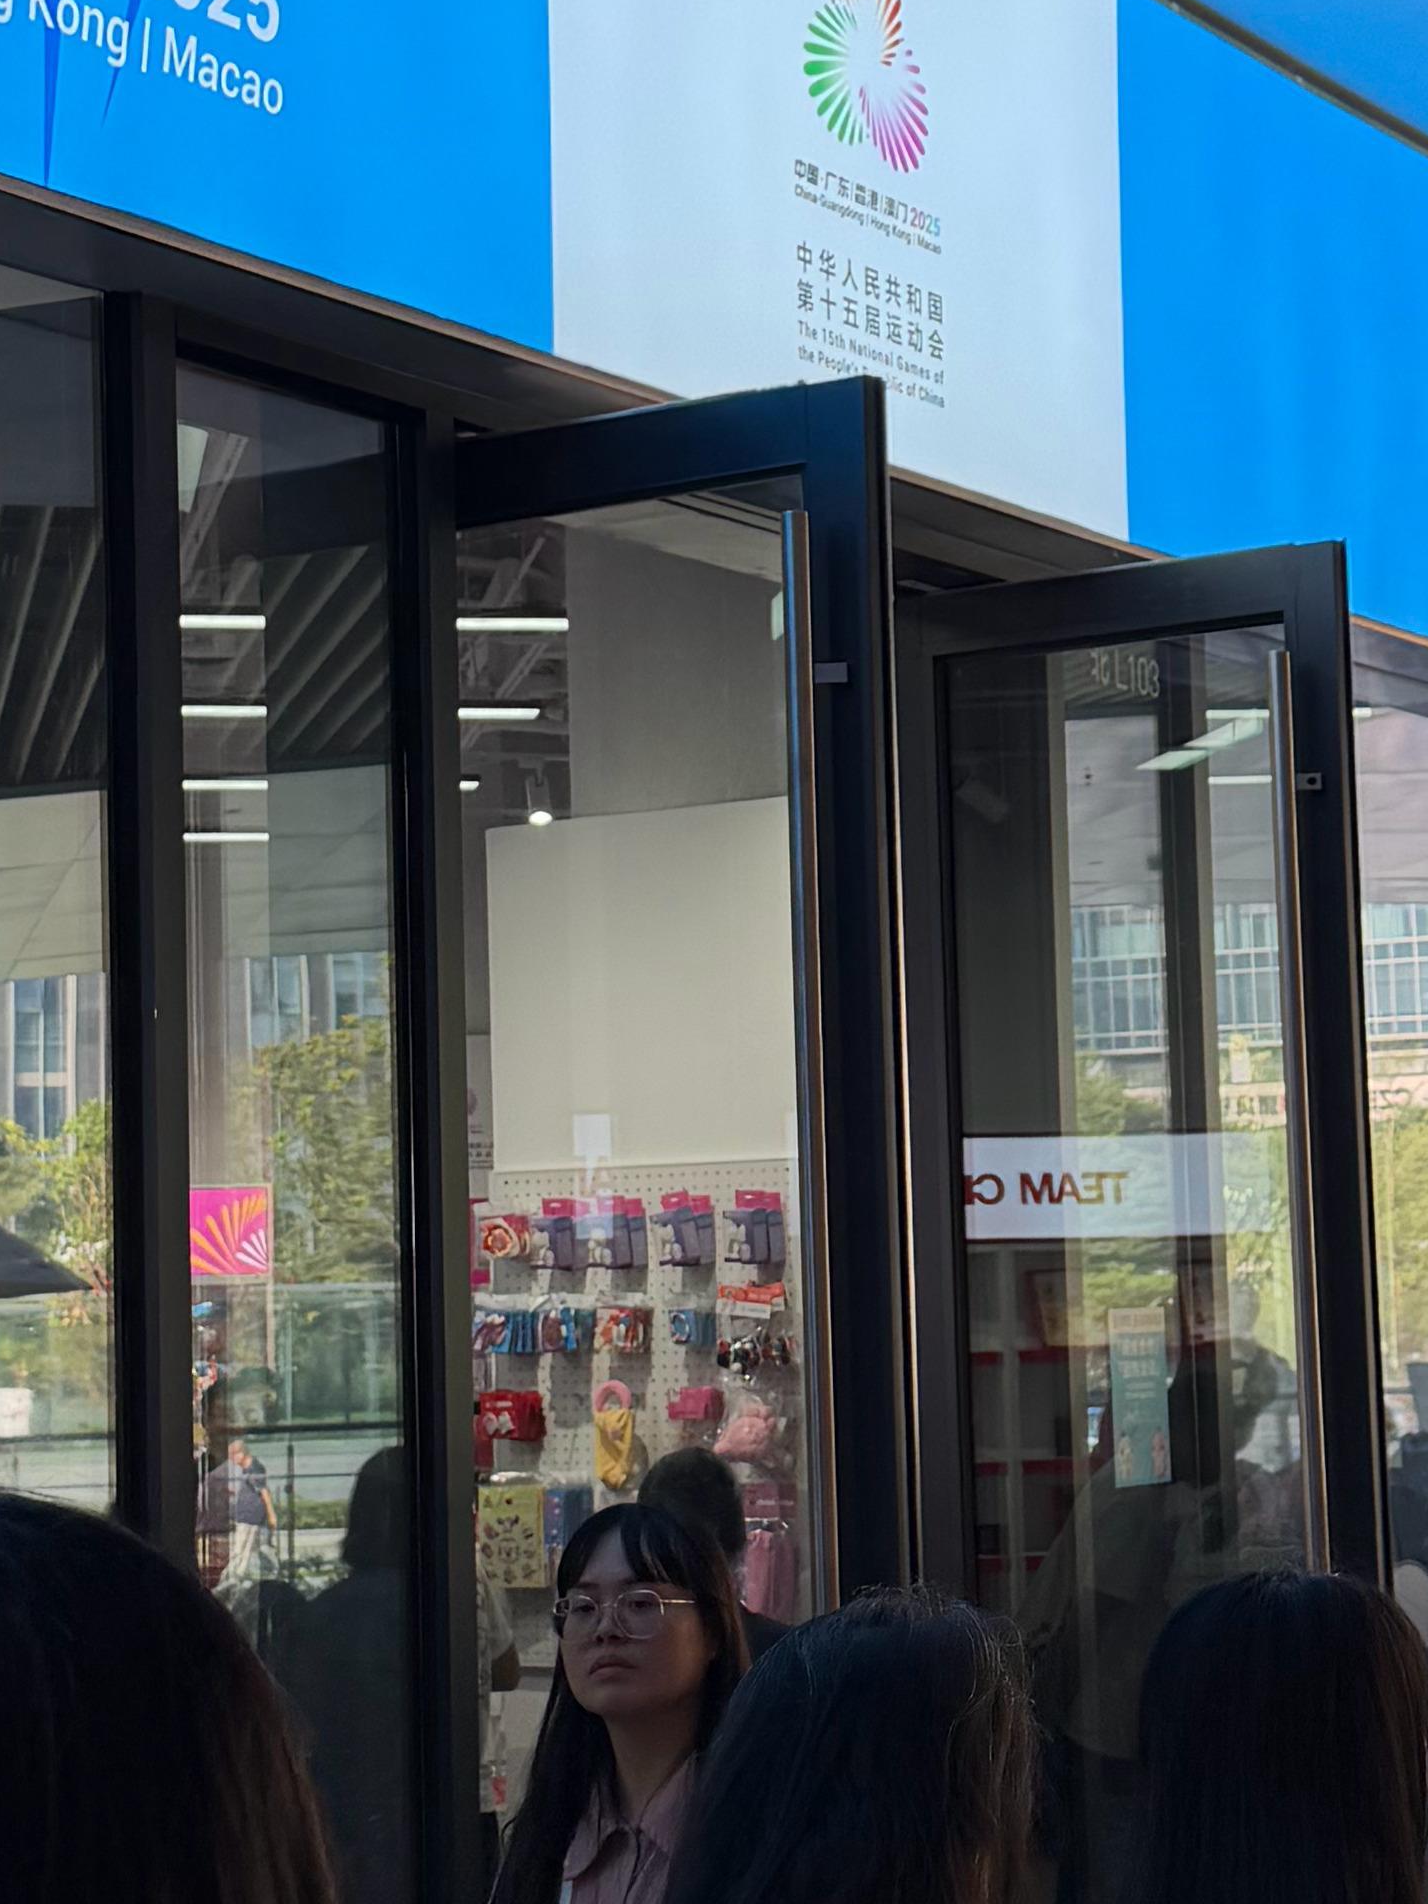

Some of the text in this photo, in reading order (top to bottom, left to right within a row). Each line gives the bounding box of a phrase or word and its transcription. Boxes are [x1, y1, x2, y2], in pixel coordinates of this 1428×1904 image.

[163, 27, 282, 114] Macao
[910, 207, 941, 237] 2025
[796, 240, 943, 325] 中华人民共和国
[796, 278, 944, 361] 第十五届运动会
[797, 319, 818, 341] The
[822, 328, 846, 350] 15th
[849, 338, 894, 367] National
[896, 355, 931, 381] Games
[934, 370, 945, 385] of
[797, 345, 815, 362] the
